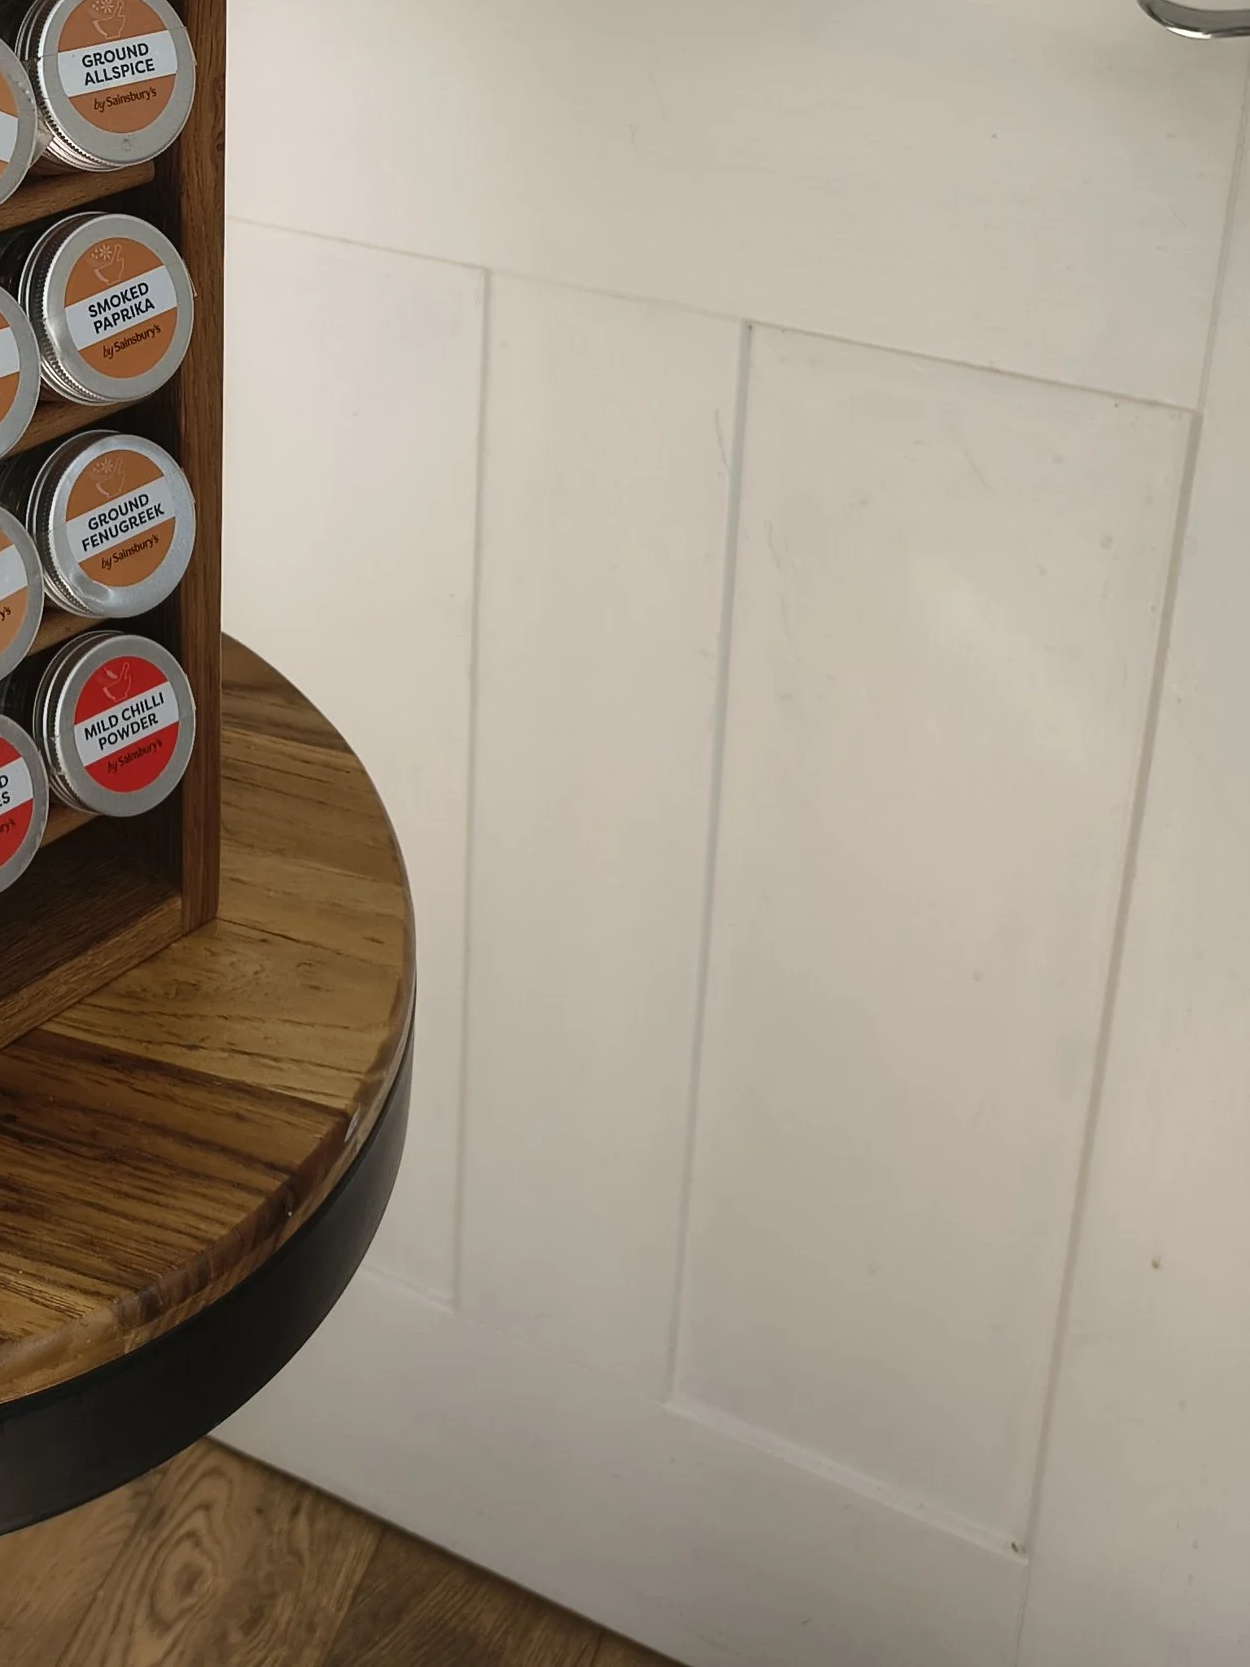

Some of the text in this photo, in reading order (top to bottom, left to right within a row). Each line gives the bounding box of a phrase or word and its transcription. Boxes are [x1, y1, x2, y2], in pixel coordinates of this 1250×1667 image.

[81, 43, 149, 68] GROUND
[84, 59, 156, 86] ALLSPICE
[93, 87, 157, 112] by Sainsbury's
[88, 282, 150, 318] SMOKED
[93, 298, 155, 334] PAPRIKA
[103, 323, 162, 359] by Sainsbury's
[82, 503, 165, 551] FENUGREEK
[88, 493, 150, 531] GROUND
[101, 534, 159, 569] by Sainsbury's
[84, 692, 165, 741] MILD CHILLI
[98, 713, 158, 750] POWDER
[107, 760, 118, 773] by
